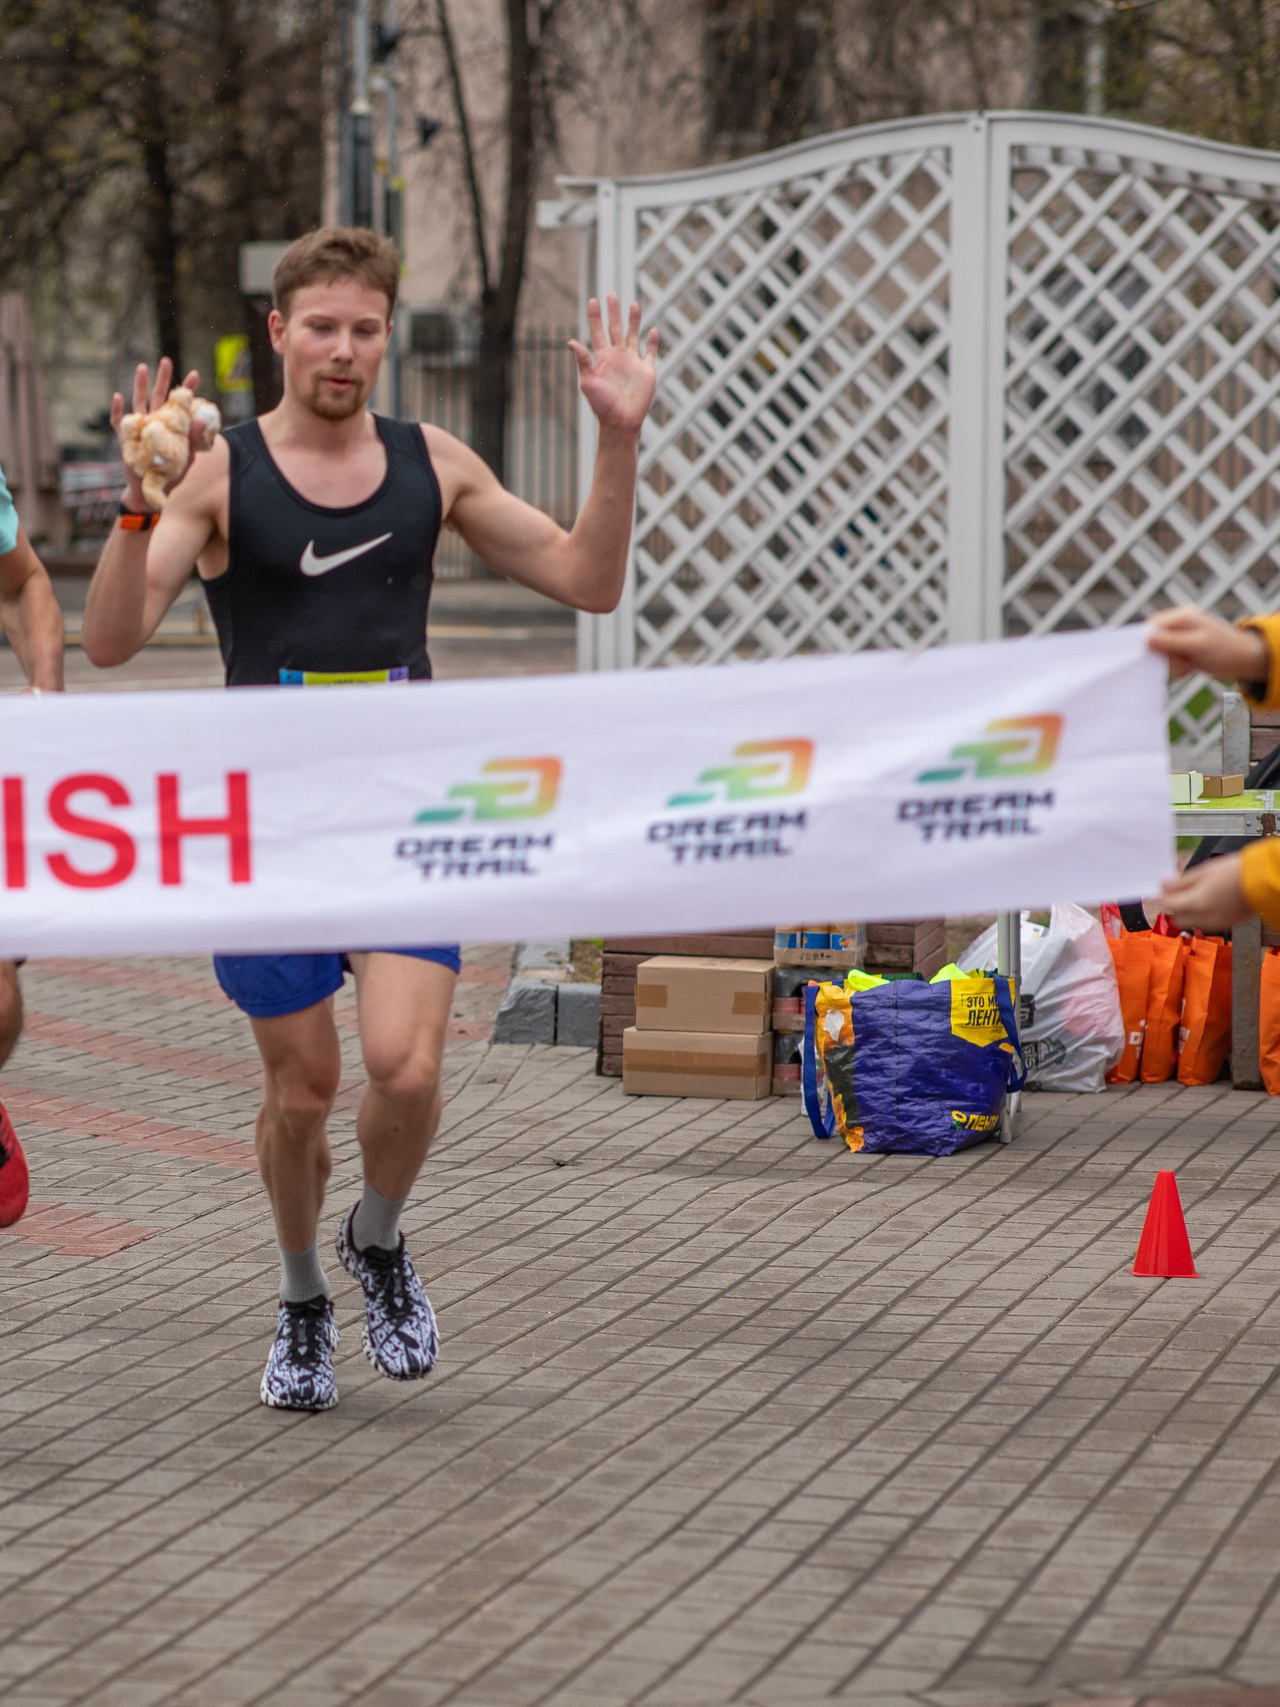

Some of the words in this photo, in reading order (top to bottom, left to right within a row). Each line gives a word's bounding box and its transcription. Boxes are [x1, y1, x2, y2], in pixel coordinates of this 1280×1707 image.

[897, 790, 1055, 823] DREAM
[647, 810, 807, 844] DREAM
[918, 817, 1041, 843] TRAIL
[394, 831, 555, 860] DREAM
[670, 837, 794, 864] TRAIL
[418, 857, 538, 880] TRAIL
[966, 996, 985, 1008] ЭТО
